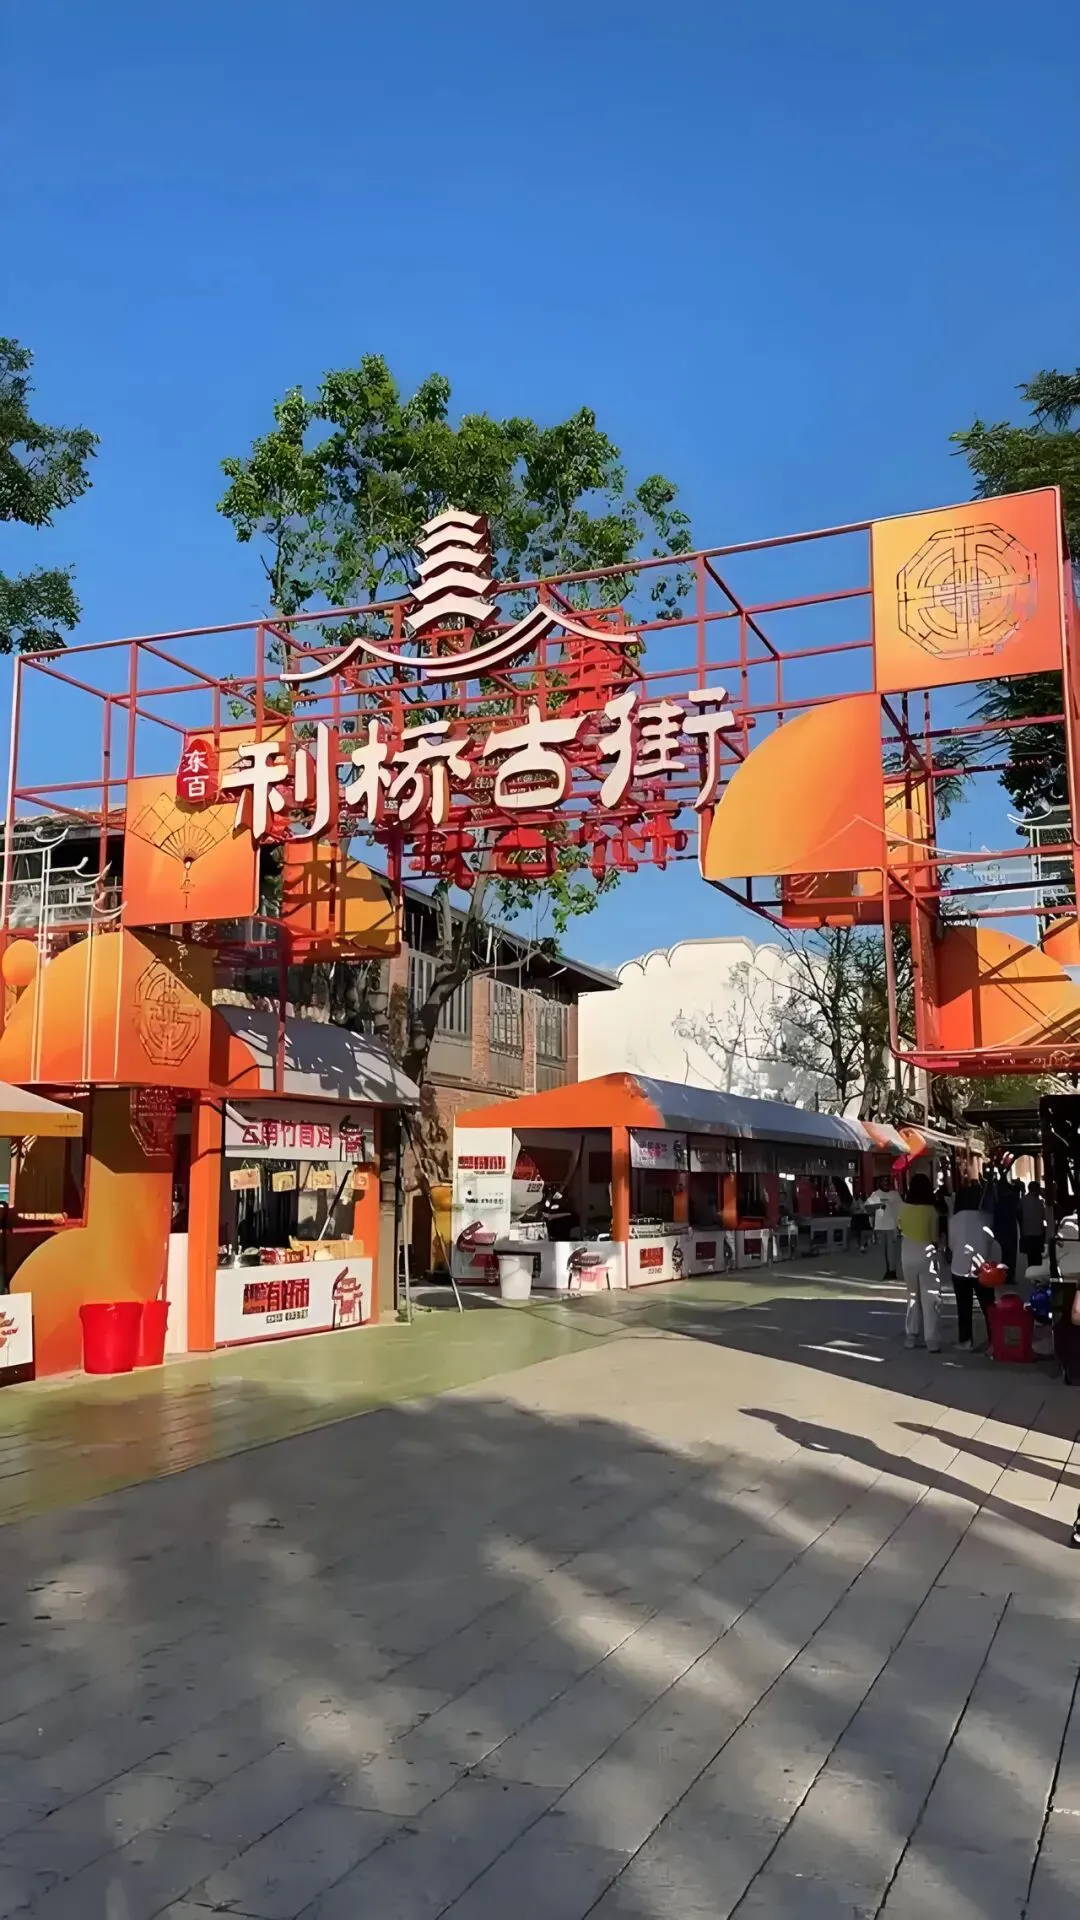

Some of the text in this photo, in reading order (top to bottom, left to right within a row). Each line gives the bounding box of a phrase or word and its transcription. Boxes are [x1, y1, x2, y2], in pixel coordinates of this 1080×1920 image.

[182, 748, 210, 798] 东百
[221, 686, 738, 840] 利桥古街
